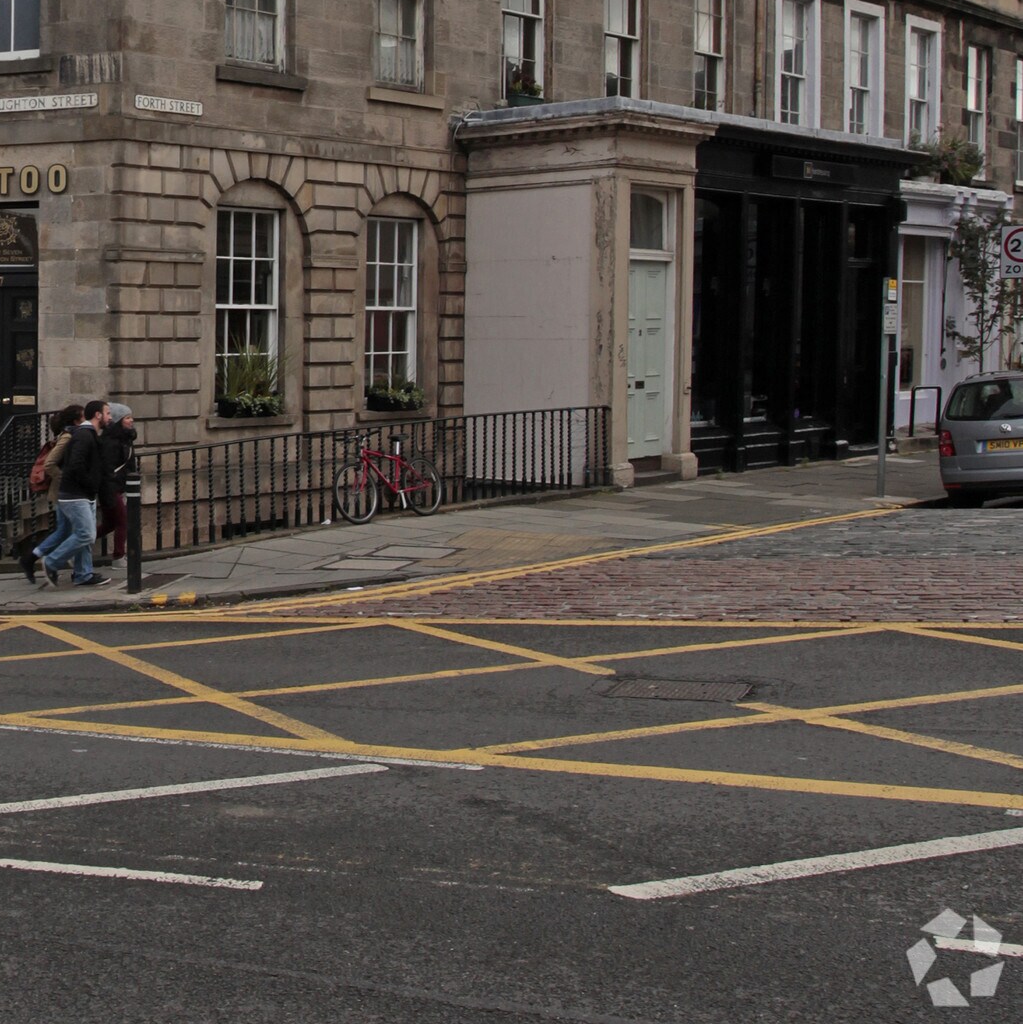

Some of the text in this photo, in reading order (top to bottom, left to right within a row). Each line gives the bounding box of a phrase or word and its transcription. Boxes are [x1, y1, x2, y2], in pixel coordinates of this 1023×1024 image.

[52, 95, 95, 107] STREET
[137, 96, 201, 114] FORTH STREET
